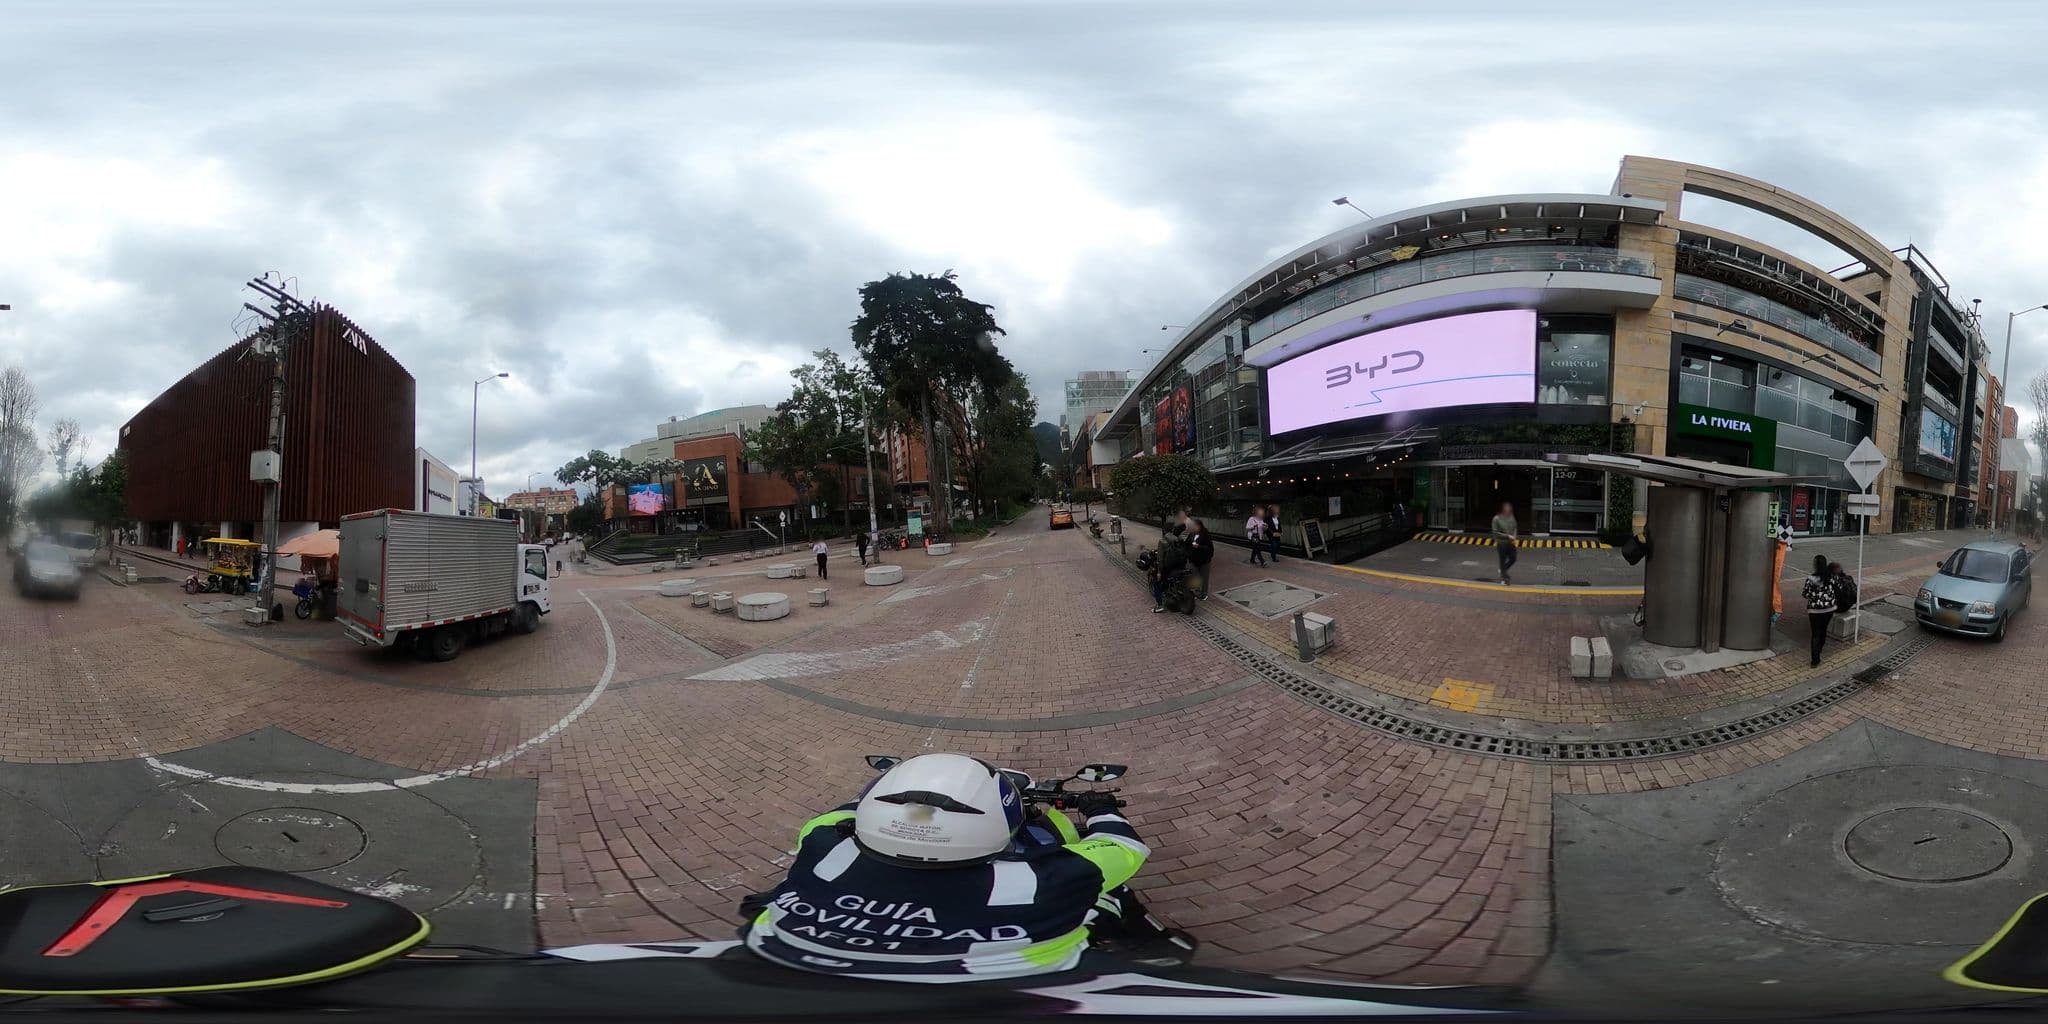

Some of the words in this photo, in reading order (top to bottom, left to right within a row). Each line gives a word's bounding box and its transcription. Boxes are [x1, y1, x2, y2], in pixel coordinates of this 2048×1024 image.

[1326, 350, 1424, 389] BYD
[1692, 413, 1707, 426] LA
[1711, 416, 1752, 433] RIVIERA
[1554, 471, 1577, 479] 12-07
[1768, 503, 1778, 535] TINTO
[776, 891, 1028, 941] MOVILIDAD
[834, 894, 937, 923] GUÍA
[792, 925, 902, 950] AF01
